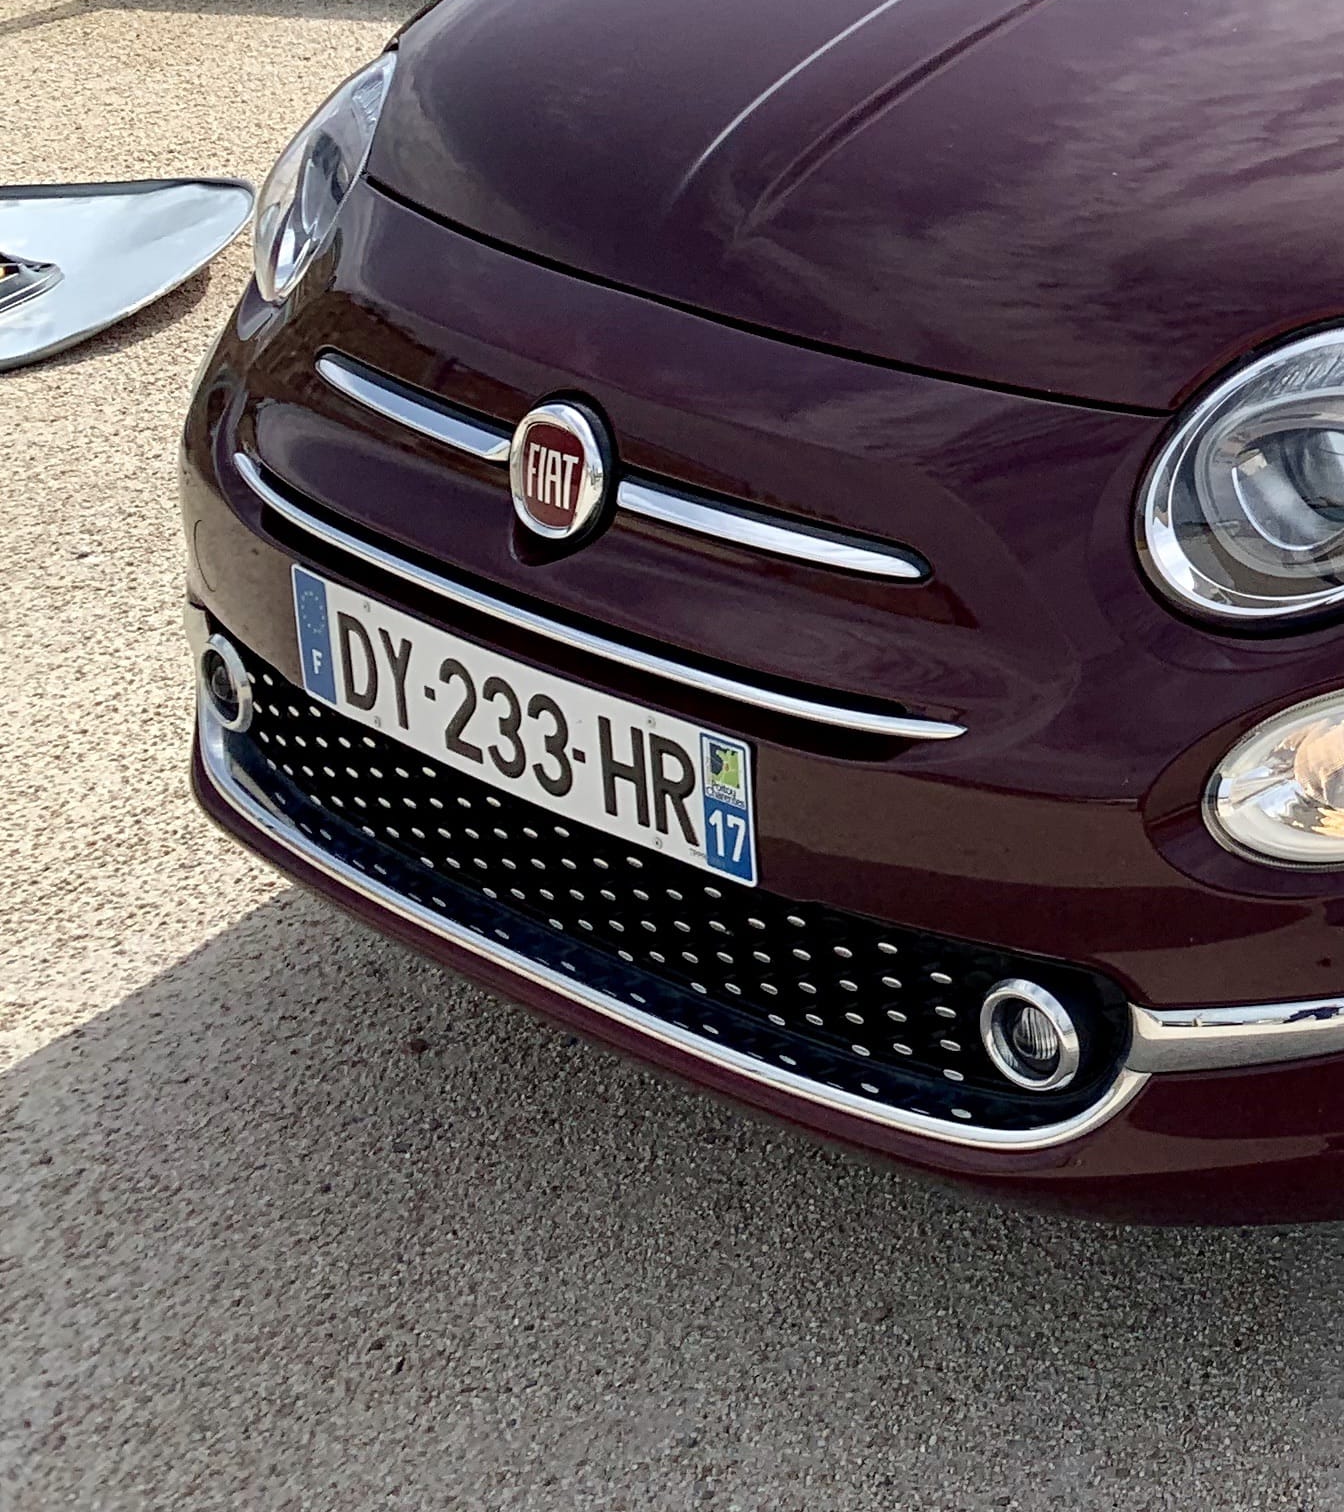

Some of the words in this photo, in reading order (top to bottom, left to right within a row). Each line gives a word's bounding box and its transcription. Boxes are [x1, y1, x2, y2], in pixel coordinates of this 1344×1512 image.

[526, 442, 580, 510] FIAT
[311, 648, 323, 675] F
[336, 610, 700, 847] DY-233-HR
[708, 808, 746, 863] 17
